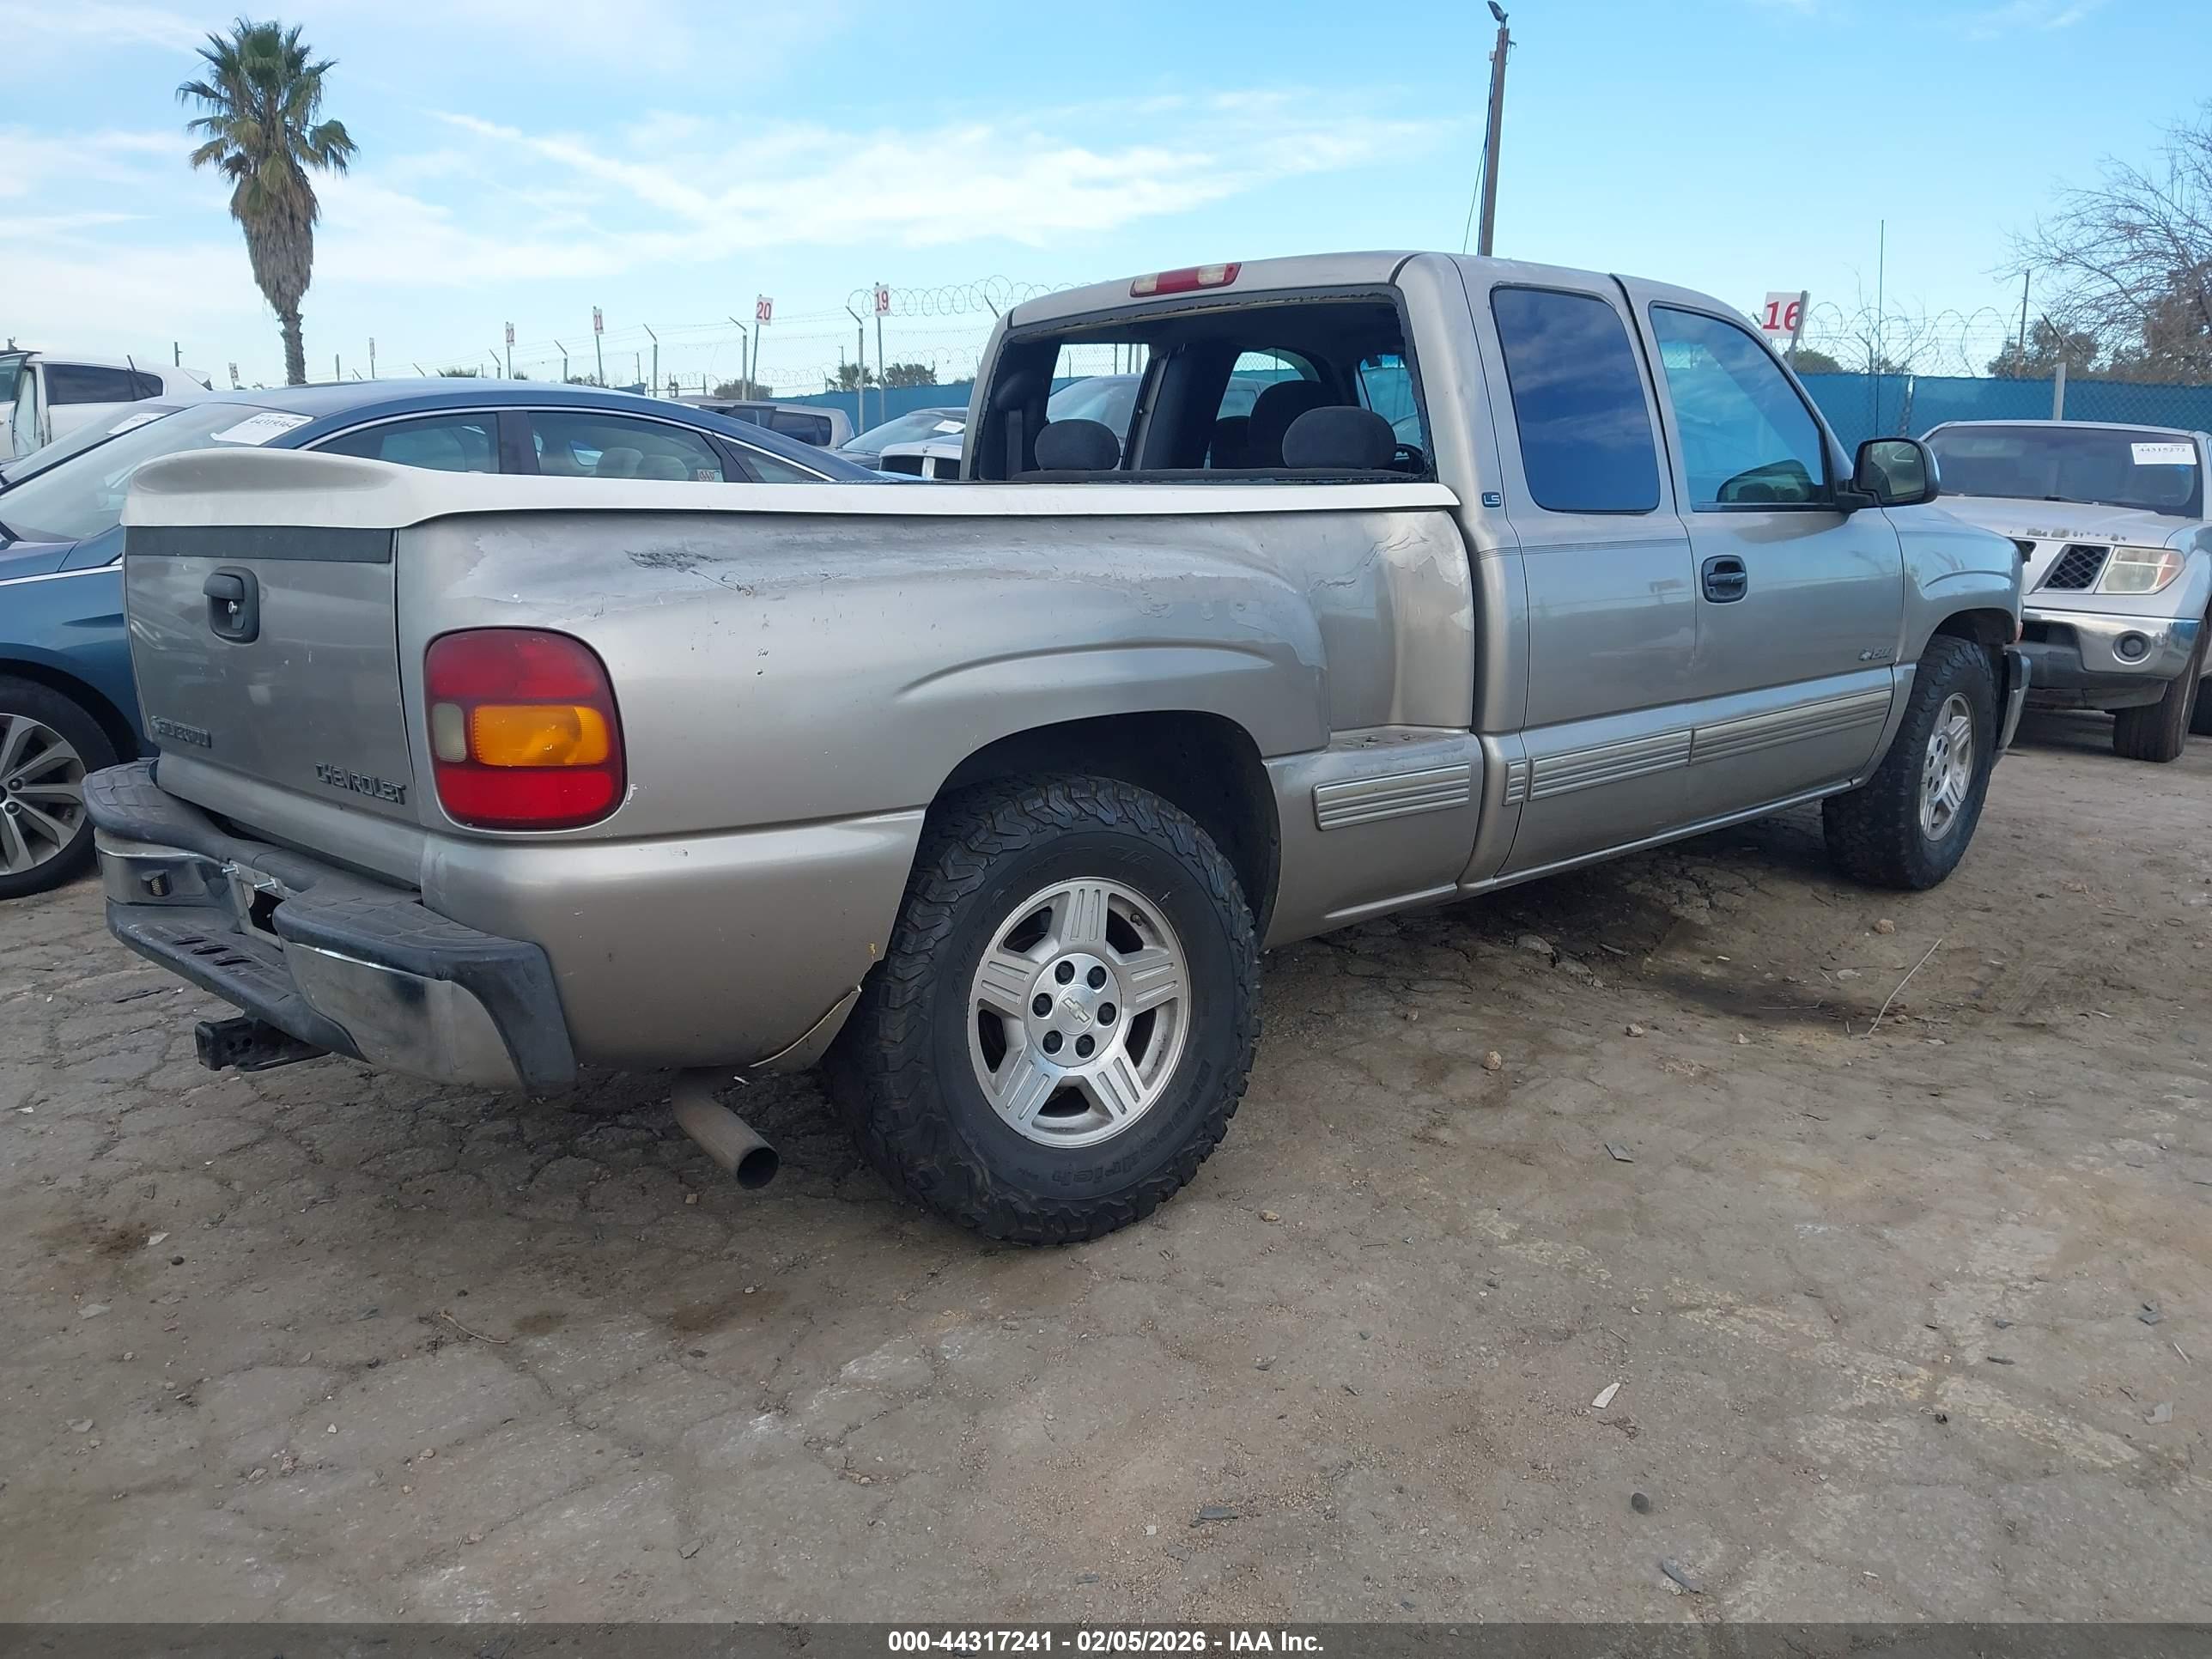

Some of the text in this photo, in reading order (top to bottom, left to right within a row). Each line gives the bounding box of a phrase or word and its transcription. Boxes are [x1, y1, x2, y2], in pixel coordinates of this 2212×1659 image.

[876, 290, 889, 311] 19
[756, 301, 772, 320] 20
[1763, 301, 1802, 331] 16
[593, 314, 603, 331] 21
[506, 328, 514, 343] 22
[229, 367, 239, 379] 25
[1483, 495, 1500, 505] LS
[315, 762, 406, 805] CHEVROLET
